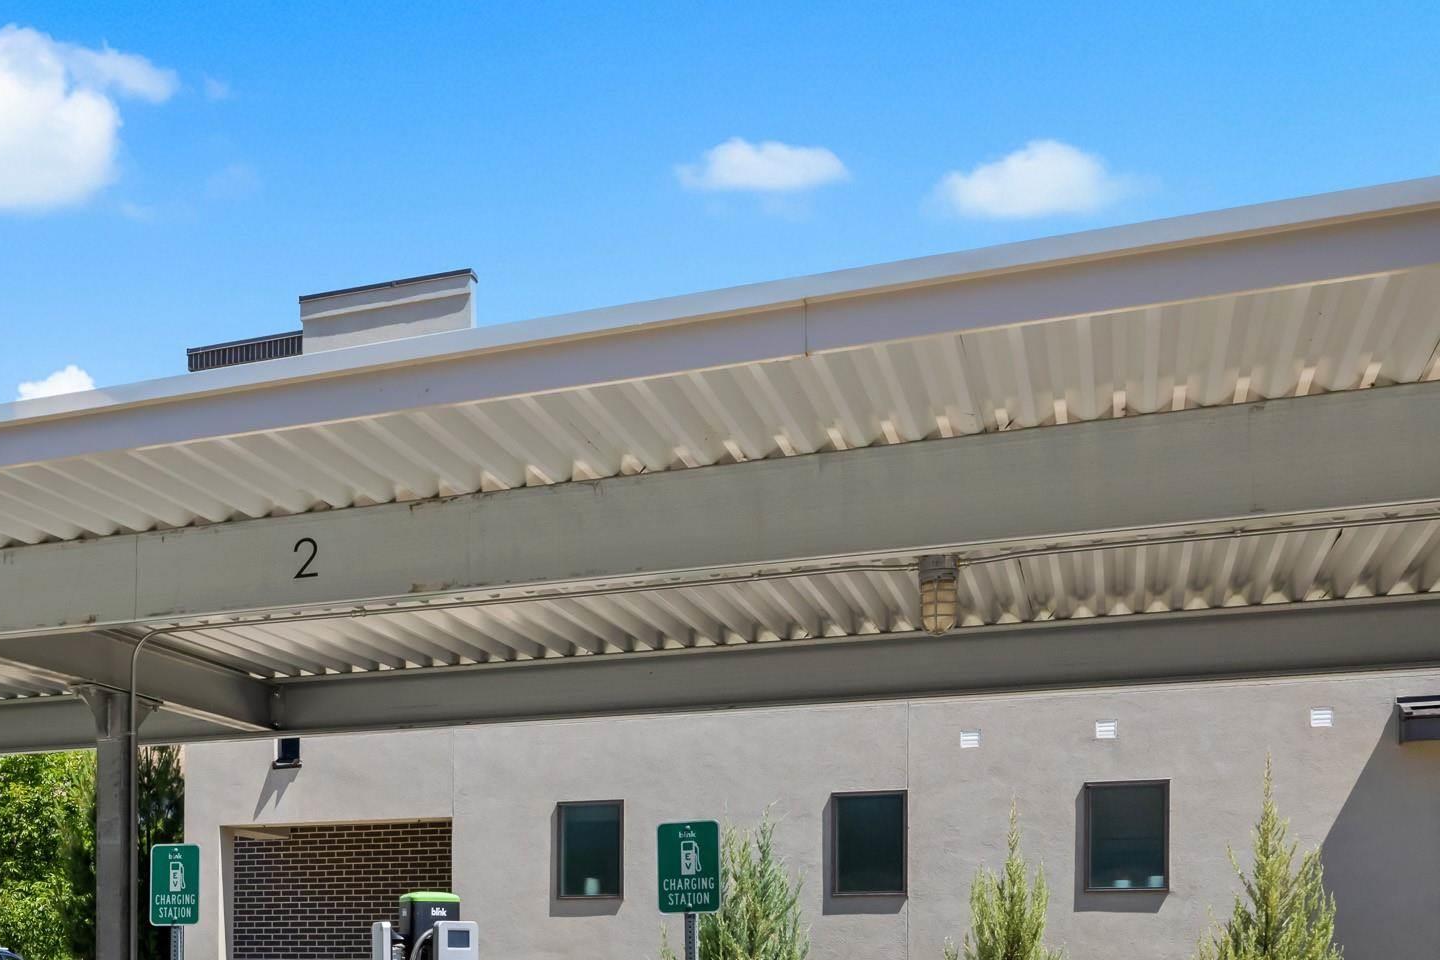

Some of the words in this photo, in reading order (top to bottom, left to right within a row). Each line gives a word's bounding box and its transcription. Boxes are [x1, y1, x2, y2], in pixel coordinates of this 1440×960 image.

[293, 537, 318, 579] 2
[663, 877, 715, 891] CHARGING
[155, 894, 195, 905] CHARGING
[668, 892, 710, 906] STATION
[158, 907, 192, 918] STATION
[430, 907, 447, 916] blink
